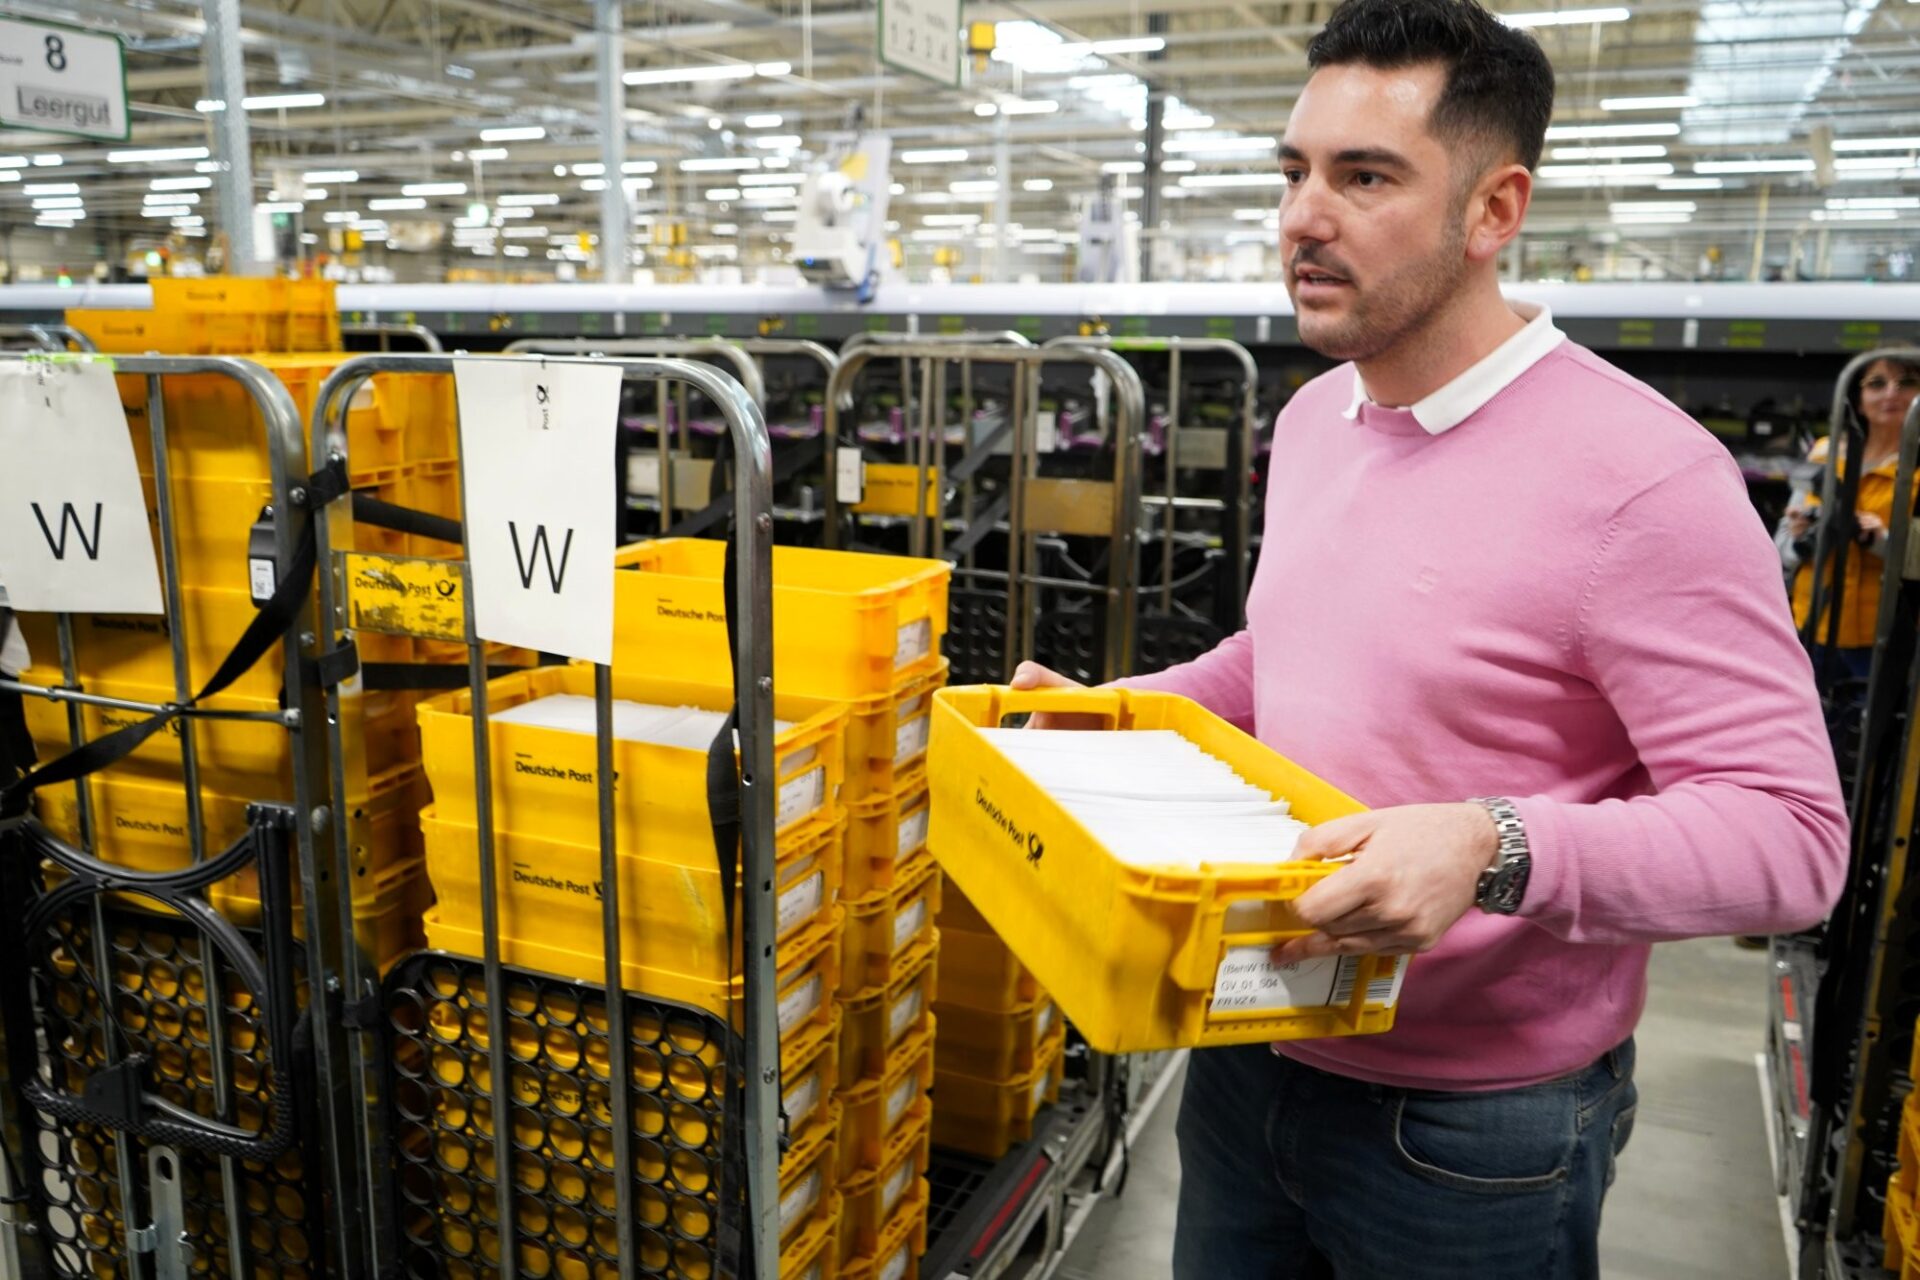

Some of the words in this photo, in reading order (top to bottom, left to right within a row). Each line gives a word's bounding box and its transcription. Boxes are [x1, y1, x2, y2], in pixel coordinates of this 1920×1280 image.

[44, 34, 67, 72] 8
[16, 86, 111, 128] Leergut
[30, 501, 103, 561] W
[507, 520, 574, 594] W
[407, 582, 431, 595] Post
[657, 605, 704, 620] Deutsche
[515, 761, 566, 779] Deutsche
[568, 770, 593, 783] Post
[115, 816, 161, 834] Deutsche
[162, 823, 185, 837] Post
[976, 788, 1008, 831] Deutsche
[1008, 819, 1024, 848] Post
[513, 870, 564, 890] Deutsche
[565, 880, 591, 895] Post
